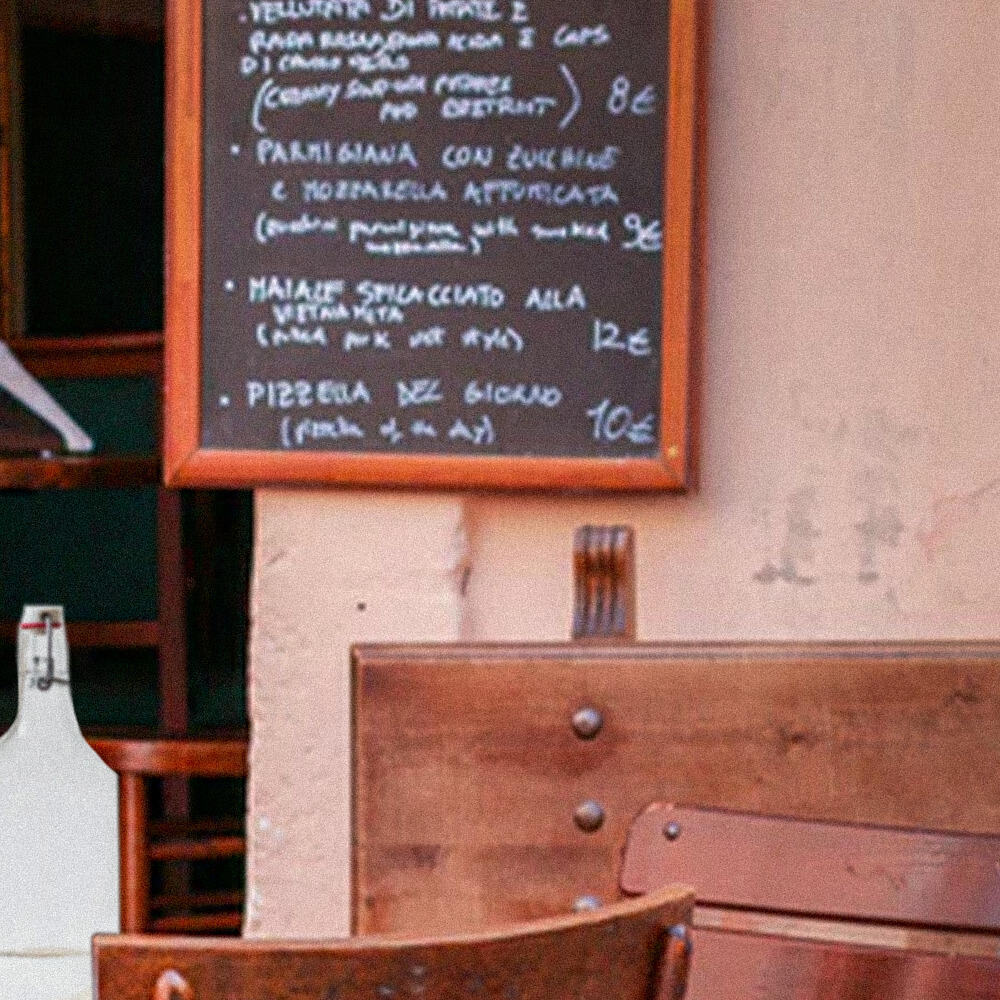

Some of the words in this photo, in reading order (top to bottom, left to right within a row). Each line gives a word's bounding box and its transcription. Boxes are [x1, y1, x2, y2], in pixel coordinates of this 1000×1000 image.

[380, 0, 414, 21] DI
[241, 56, 270, 75] DI
[607, 76, 654, 114] 8€
[257, 138, 417, 166] PARMIGIANA
[442, 145, 492, 169] CON
[526, 285, 585, 310] ALLA
[593, 319, 650, 355] 12€
[247, 381, 369, 408] PIZZELLA
[465, 381, 561, 407] GIORNO
[586, 399, 652, 443] 10€
